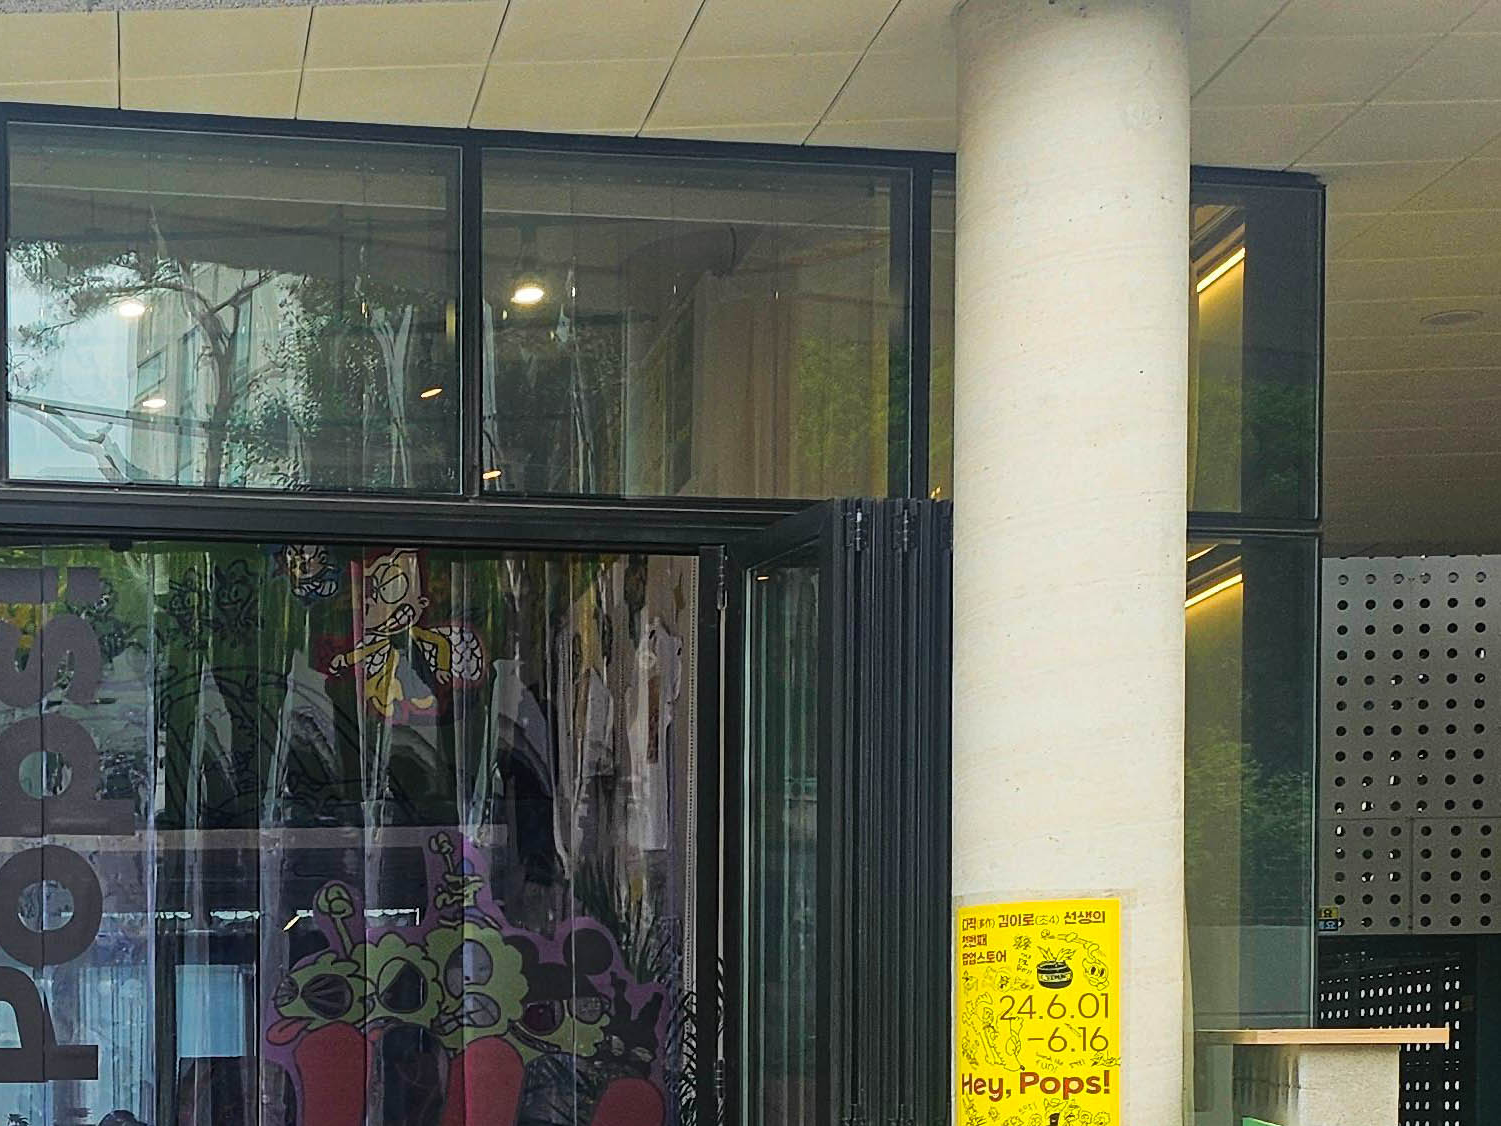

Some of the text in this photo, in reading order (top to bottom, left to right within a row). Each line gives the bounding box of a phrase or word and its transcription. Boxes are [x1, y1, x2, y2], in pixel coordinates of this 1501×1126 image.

[999, 992, 1110, 1021] 24.6.01
[961, 1069, 1111, 1102] Hey, Pops!
